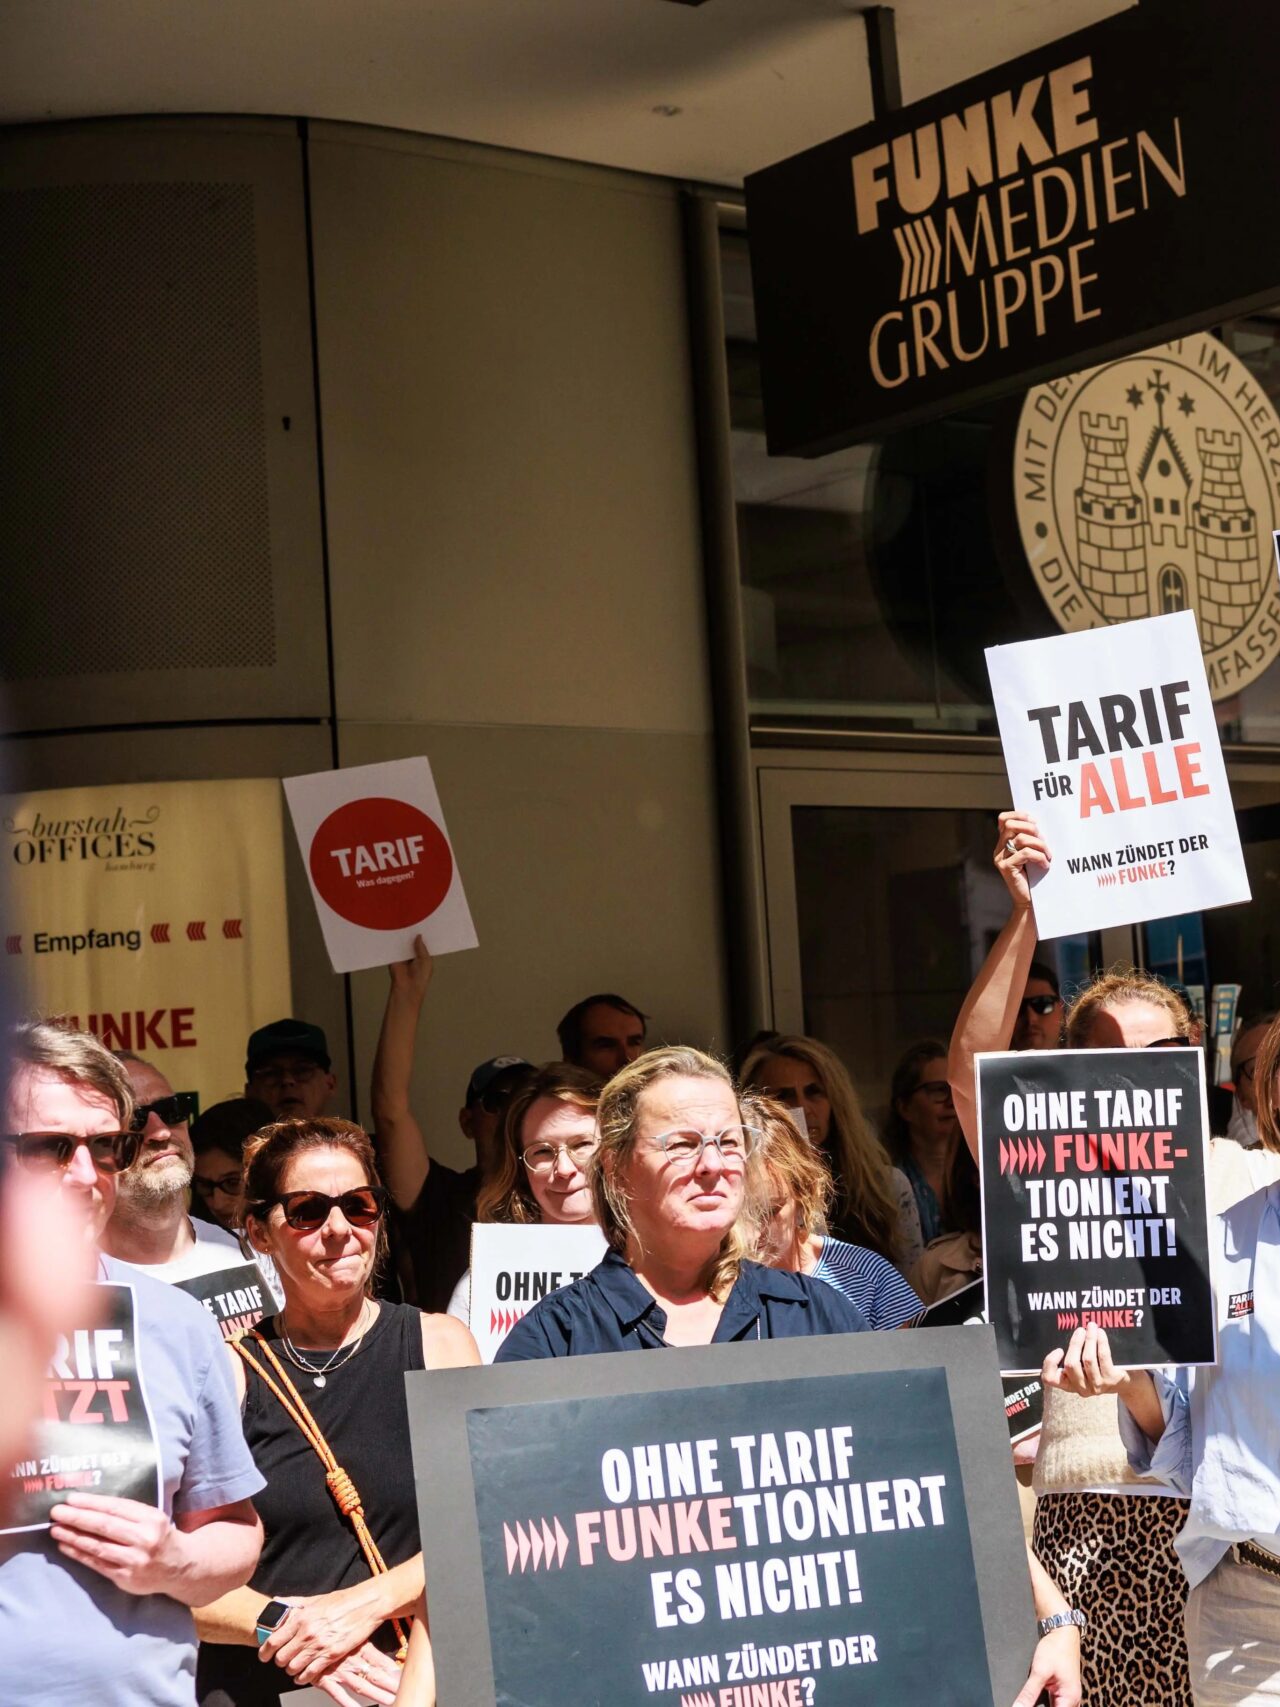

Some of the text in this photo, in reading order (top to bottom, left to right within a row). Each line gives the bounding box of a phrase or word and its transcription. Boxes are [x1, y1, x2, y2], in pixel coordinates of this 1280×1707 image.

[851, 55, 1099, 235] FUNKE
[945, 117, 1187, 284] MEDIEN
[869, 239, 1101, 389] GRUPPE
[1199, 343, 1231, 384] IM
[1025, 371, 1081, 501] MIT DE
[1040, 557, 1083, 623] DIE
[1027, 680, 1191, 764] TARIF
[1032, 742, 1210, 819] FÜR ALLE
[32, 807, 127, 838] burstah
[13, 832, 156, 865] OFFICES
[330, 834, 424, 877] TARIF
[1067, 834, 1209, 874] WANN ZÜNDET DER
[356, 870, 414, 888] Was dagegen?
[1118, 860, 1176, 885] FUNKE?
[33, 928, 142, 955] Empfang
[1003, 1088, 1183, 1132] OHNE TARIF
[1053, 1132, 1188, 1173] FUNKE-
[1025, 1175, 1170, 1219] TIONIERT
[1020, 1218, 1177, 1263] ES NICHT!
[214, 1285, 263, 1317] TARIF
[1028, 1286, 1182, 1311] WANN ZÜNDET DER
[1081, 1309, 1144, 1329] FUNKE?
[46, 1329, 123, 1379] RIF
[1004, 1381, 1041, 1407] NDET DER
[1005, 1398, 1030, 1417] UNKE?
[601, 1426, 853, 1504] OHNE TARIF
[574, 1475, 947, 1566] FUNKETIONIERT
[650, 1549, 863, 1629] ES NICHT!
[642, 1634, 878, 1692] WANN ZÜNDET DER
[719, 1676, 816, 1707] FUNKE?
